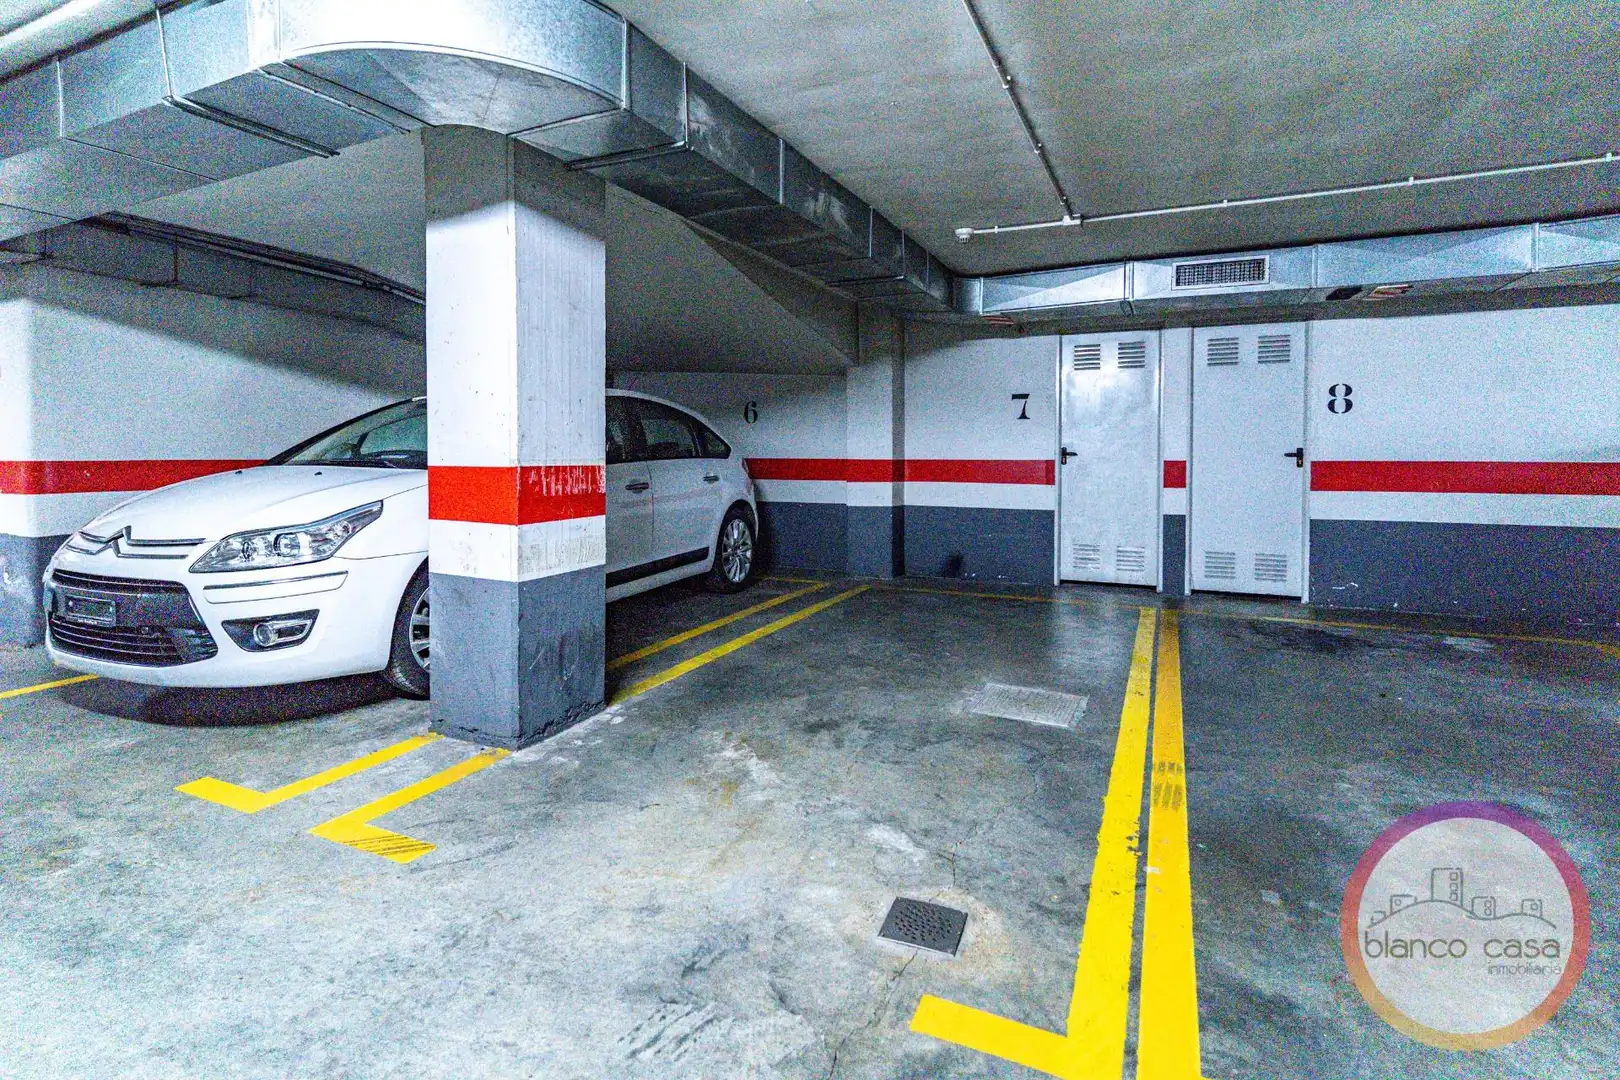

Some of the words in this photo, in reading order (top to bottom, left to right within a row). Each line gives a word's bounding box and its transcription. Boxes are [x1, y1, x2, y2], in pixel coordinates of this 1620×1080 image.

[743, 401, 759, 424] 6
[1011, 393, 1031, 420] 7
[1327, 383, 1354, 415] 8
